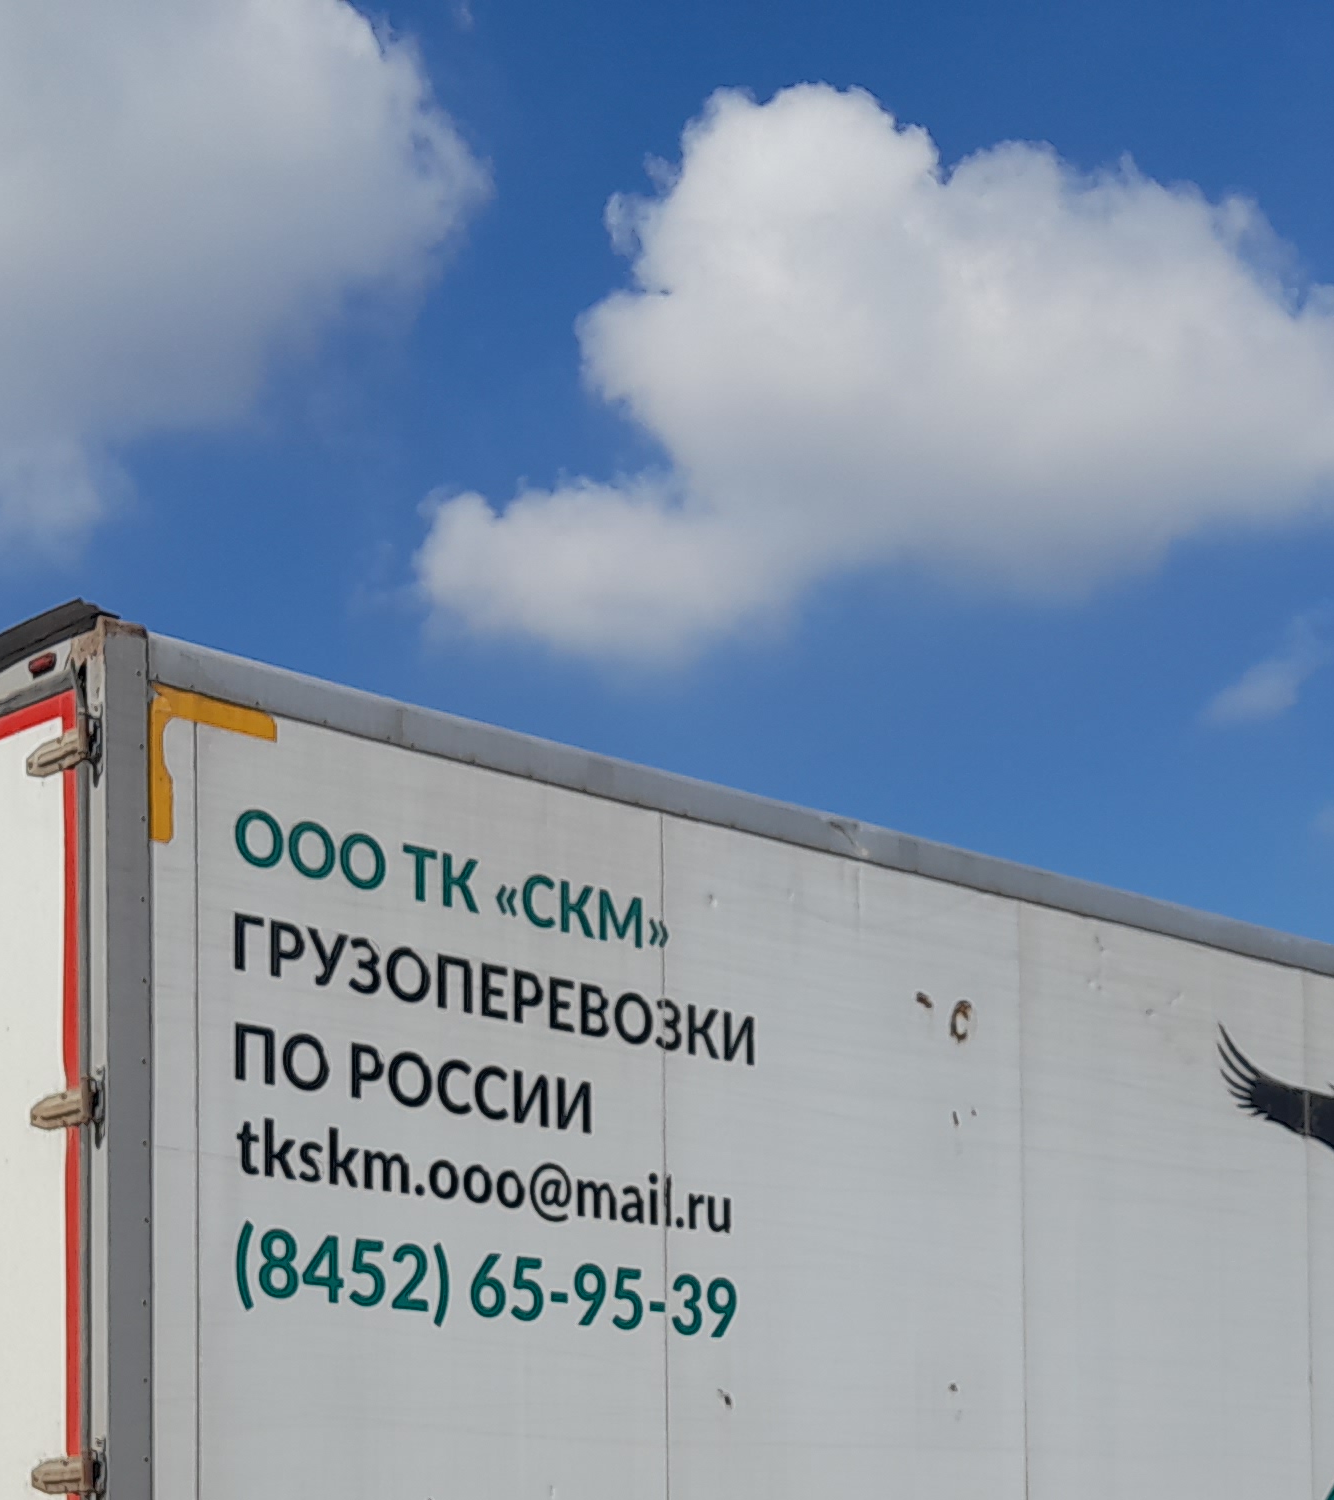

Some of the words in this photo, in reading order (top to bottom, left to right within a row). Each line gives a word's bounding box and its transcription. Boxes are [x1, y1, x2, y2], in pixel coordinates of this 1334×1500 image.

[234, 809, 387, 890] ООО
[402, 843, 480, 914] ТК
[496, 874, 670, 949] «СКМ»
[234, 912, 756, 1066] ГРУЗОПЕРЕВОЗКИ
[234, 1022, 330, 1092] ПО
[350, 1042, 593, 1135] РОССИИ
[236, 1118, 733, 1234] tkskm.ooo@mail.ru
[236, 1220, 450, 1327] (8452)
[469, 1252, 739, 1338] 65-95-39
